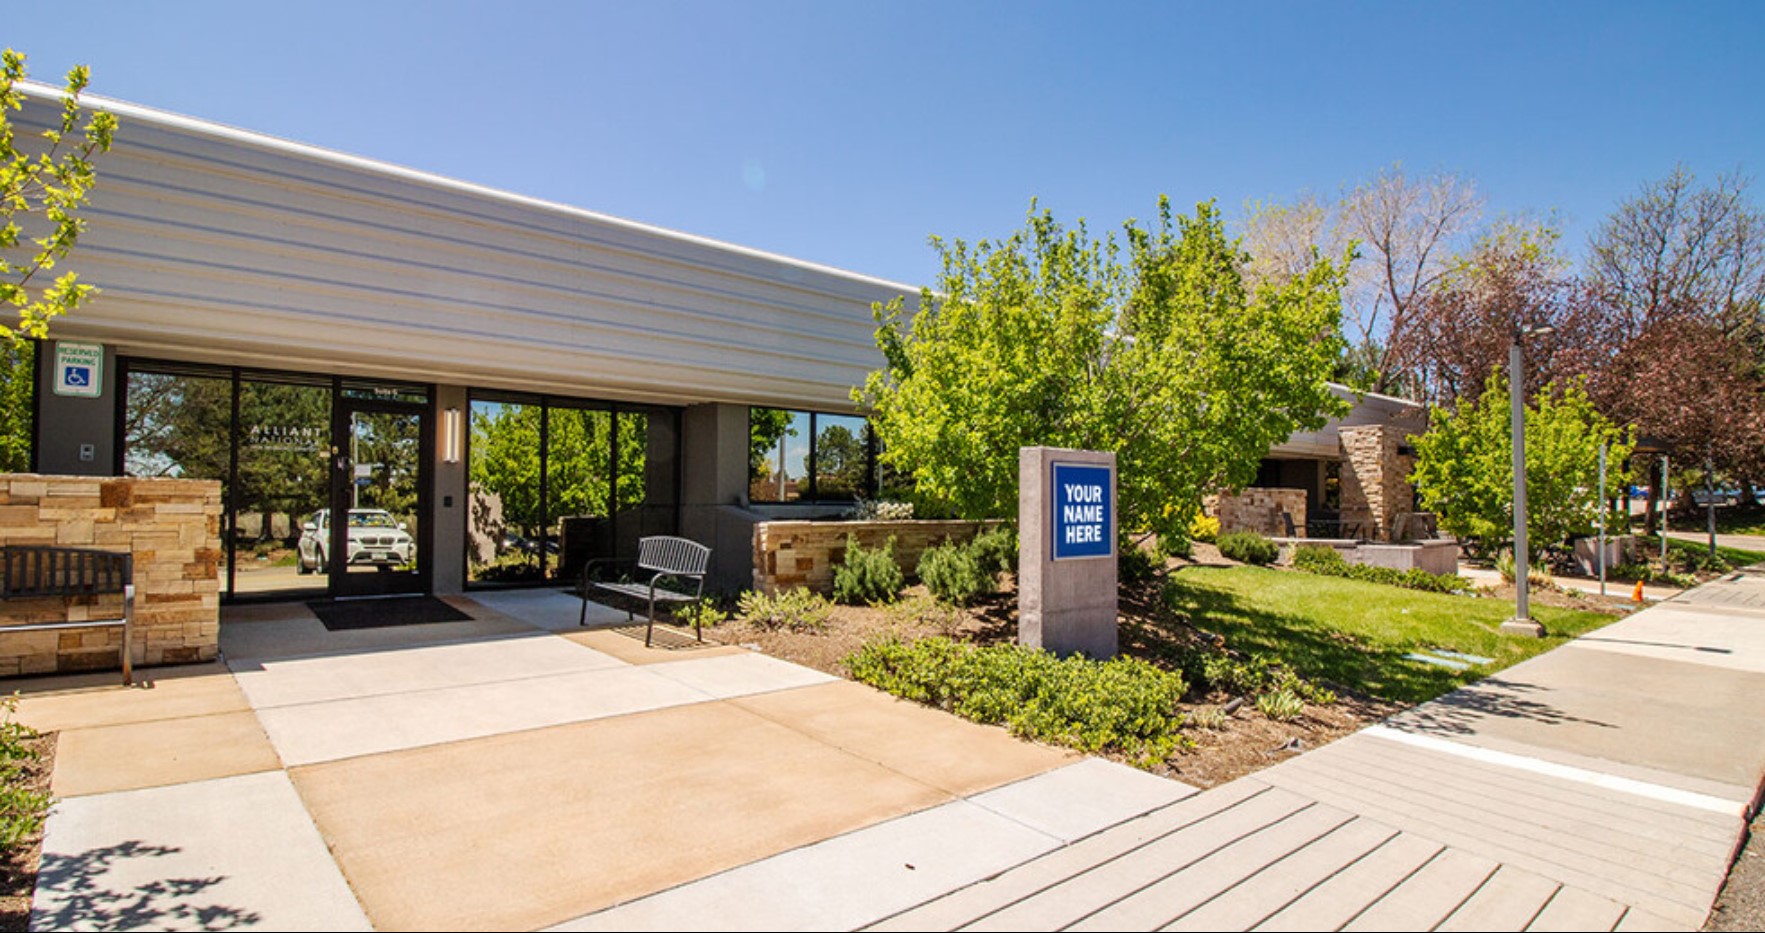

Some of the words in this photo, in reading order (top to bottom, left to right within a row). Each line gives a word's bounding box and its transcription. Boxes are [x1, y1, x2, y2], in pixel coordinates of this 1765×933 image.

[61, 356, 97, 366] PARKING
[251, 424, 321, 437] ALLIANT
[1064, 484, 1102, 502] YOUR
[1064, 505, 1103, 523] NAME
[1066, 525, 1102, 543] HERE
